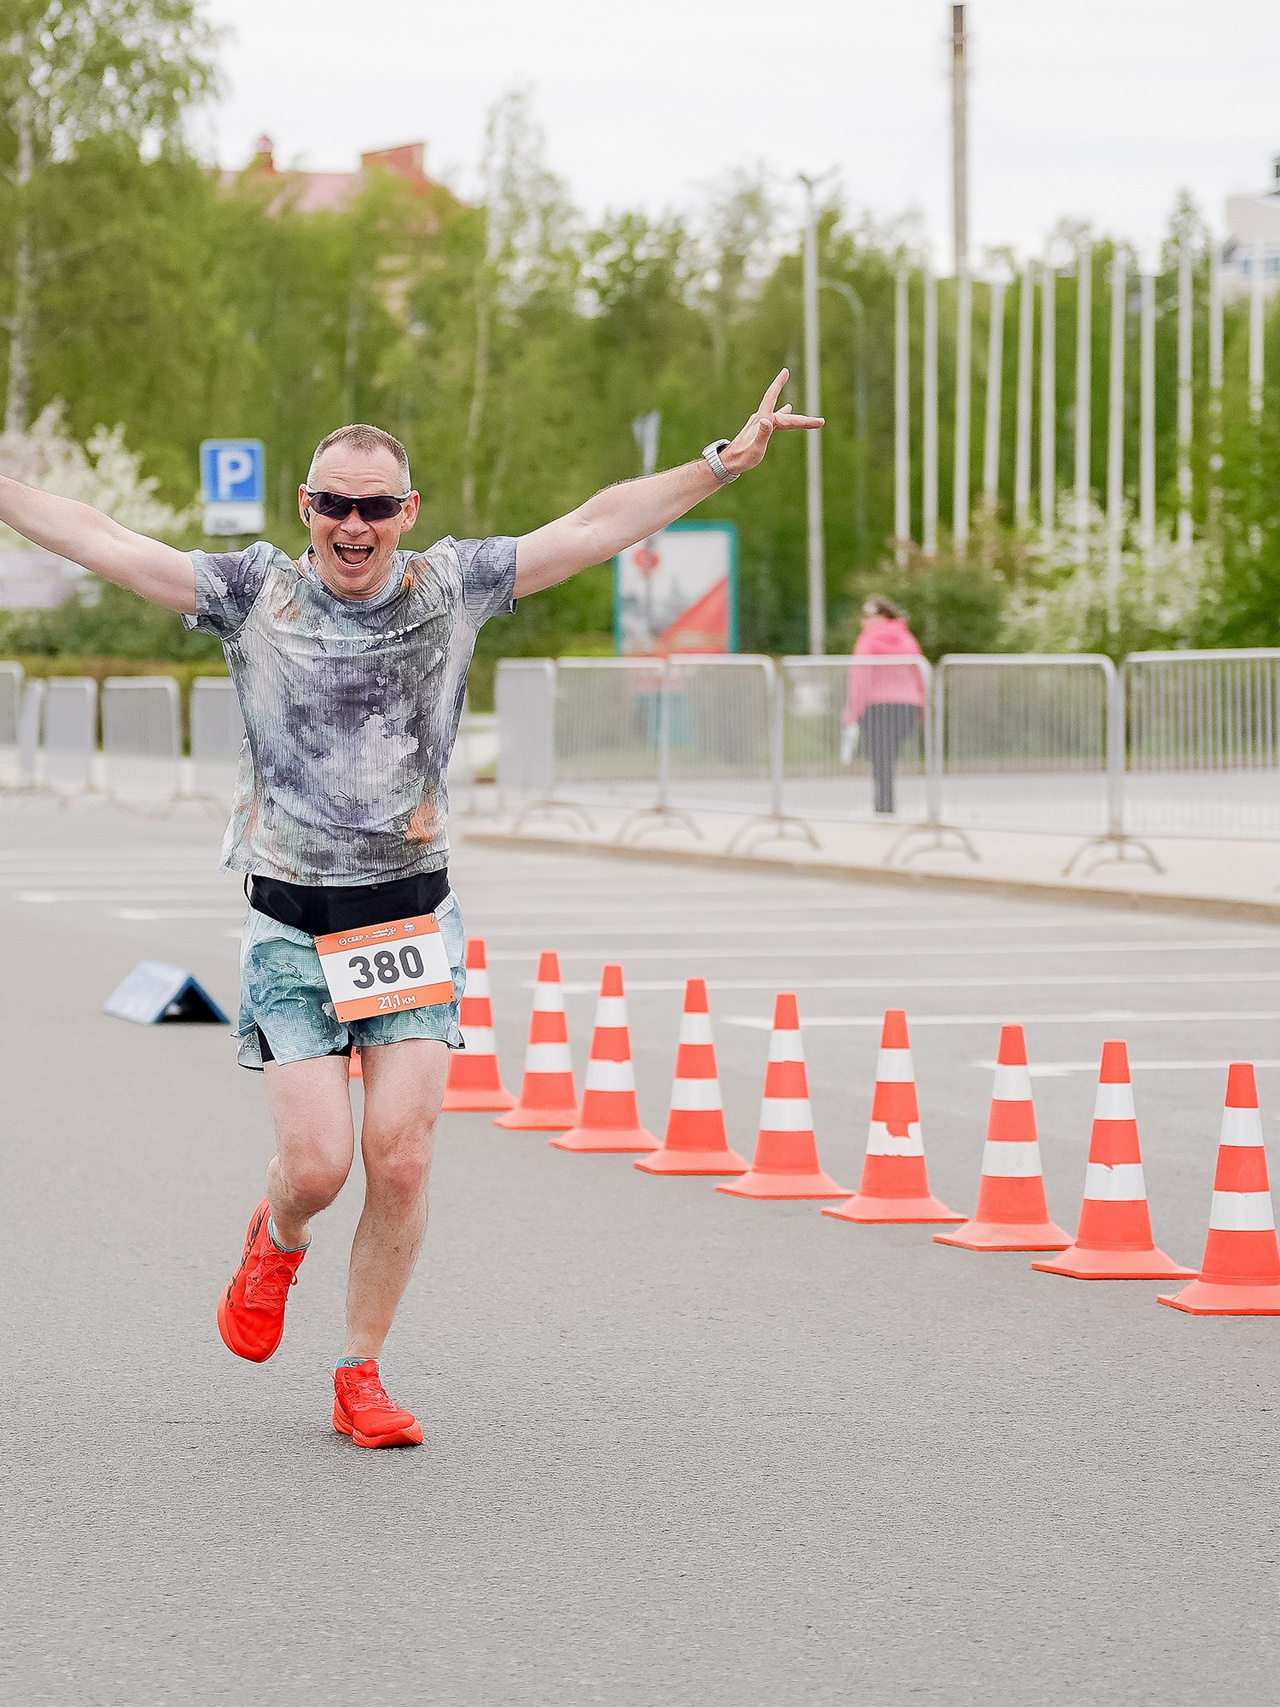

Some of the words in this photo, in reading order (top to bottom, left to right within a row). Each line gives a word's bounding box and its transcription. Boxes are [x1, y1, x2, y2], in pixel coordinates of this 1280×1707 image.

[218, 451, 252, 499] P
[348, 945, 424, 989] 380
[377, 993, 401, 1010] 21,1
